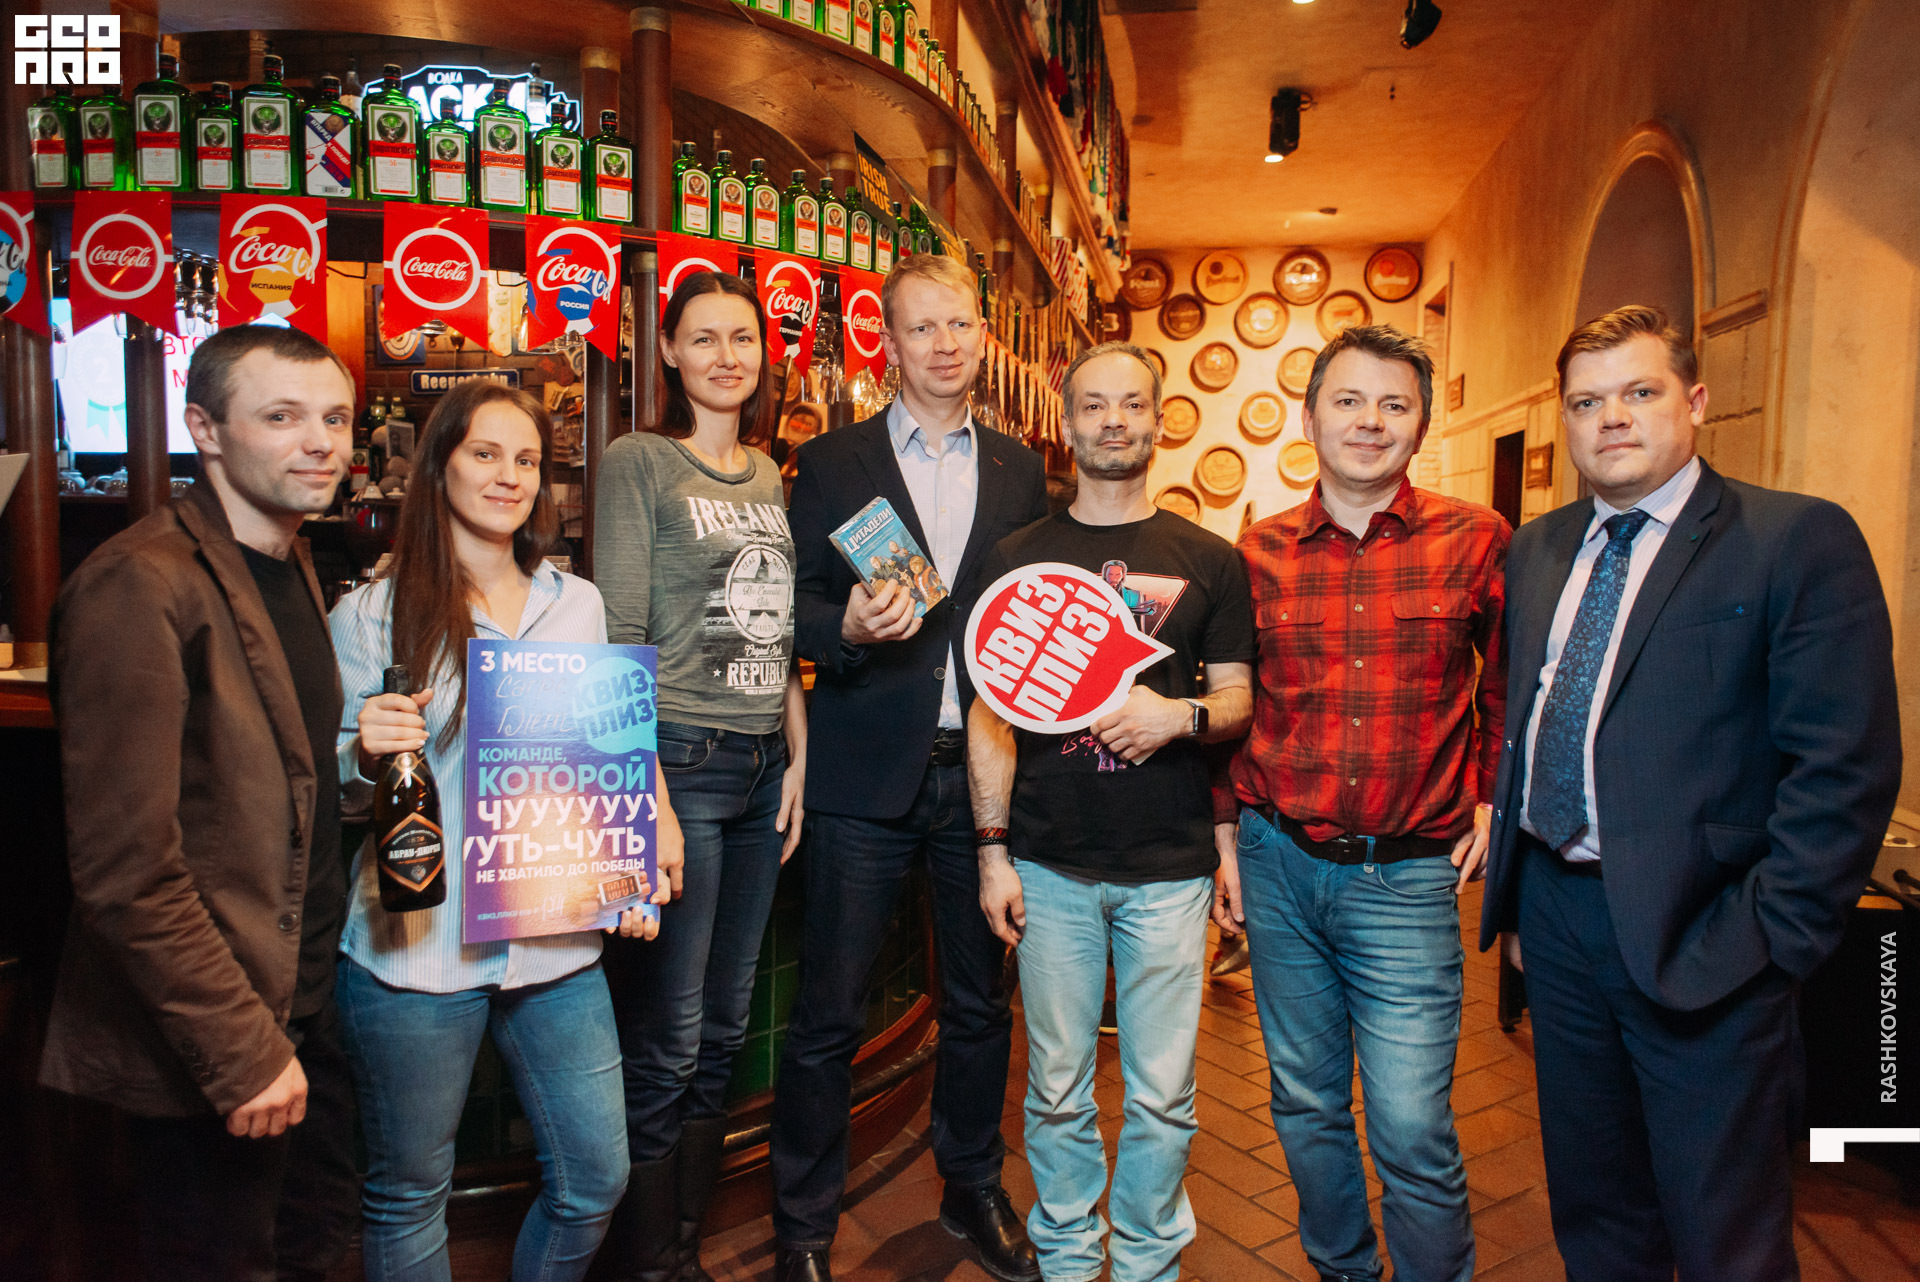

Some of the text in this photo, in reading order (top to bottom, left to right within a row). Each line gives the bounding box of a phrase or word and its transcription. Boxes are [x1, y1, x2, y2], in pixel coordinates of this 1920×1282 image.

[858, 153, 889, 195] IRISH
[862, 176, 893, 217] TRUE
[88, 245, 153, 268] Coca-Cola
[403, 256, 471, 282] Coca-Cola
[251, 283, 292, 291] ИСПАНИЯ
[560, 300, 590, 311] РОССИЯ
[686, 496, 792, 540] IRELAND
[480, 651, 587, 674] 3 МЕСТО
[1012, 585, 1119, 723] ПЛИЗ!
[478, 746, 568, 764] КОМАНДЕ,
[478, 756, 647, 797] КОТОРОЙ
[476, 858, 645, 884] НЕ ХВАТИЛО ДО ПОБЕДЫ
